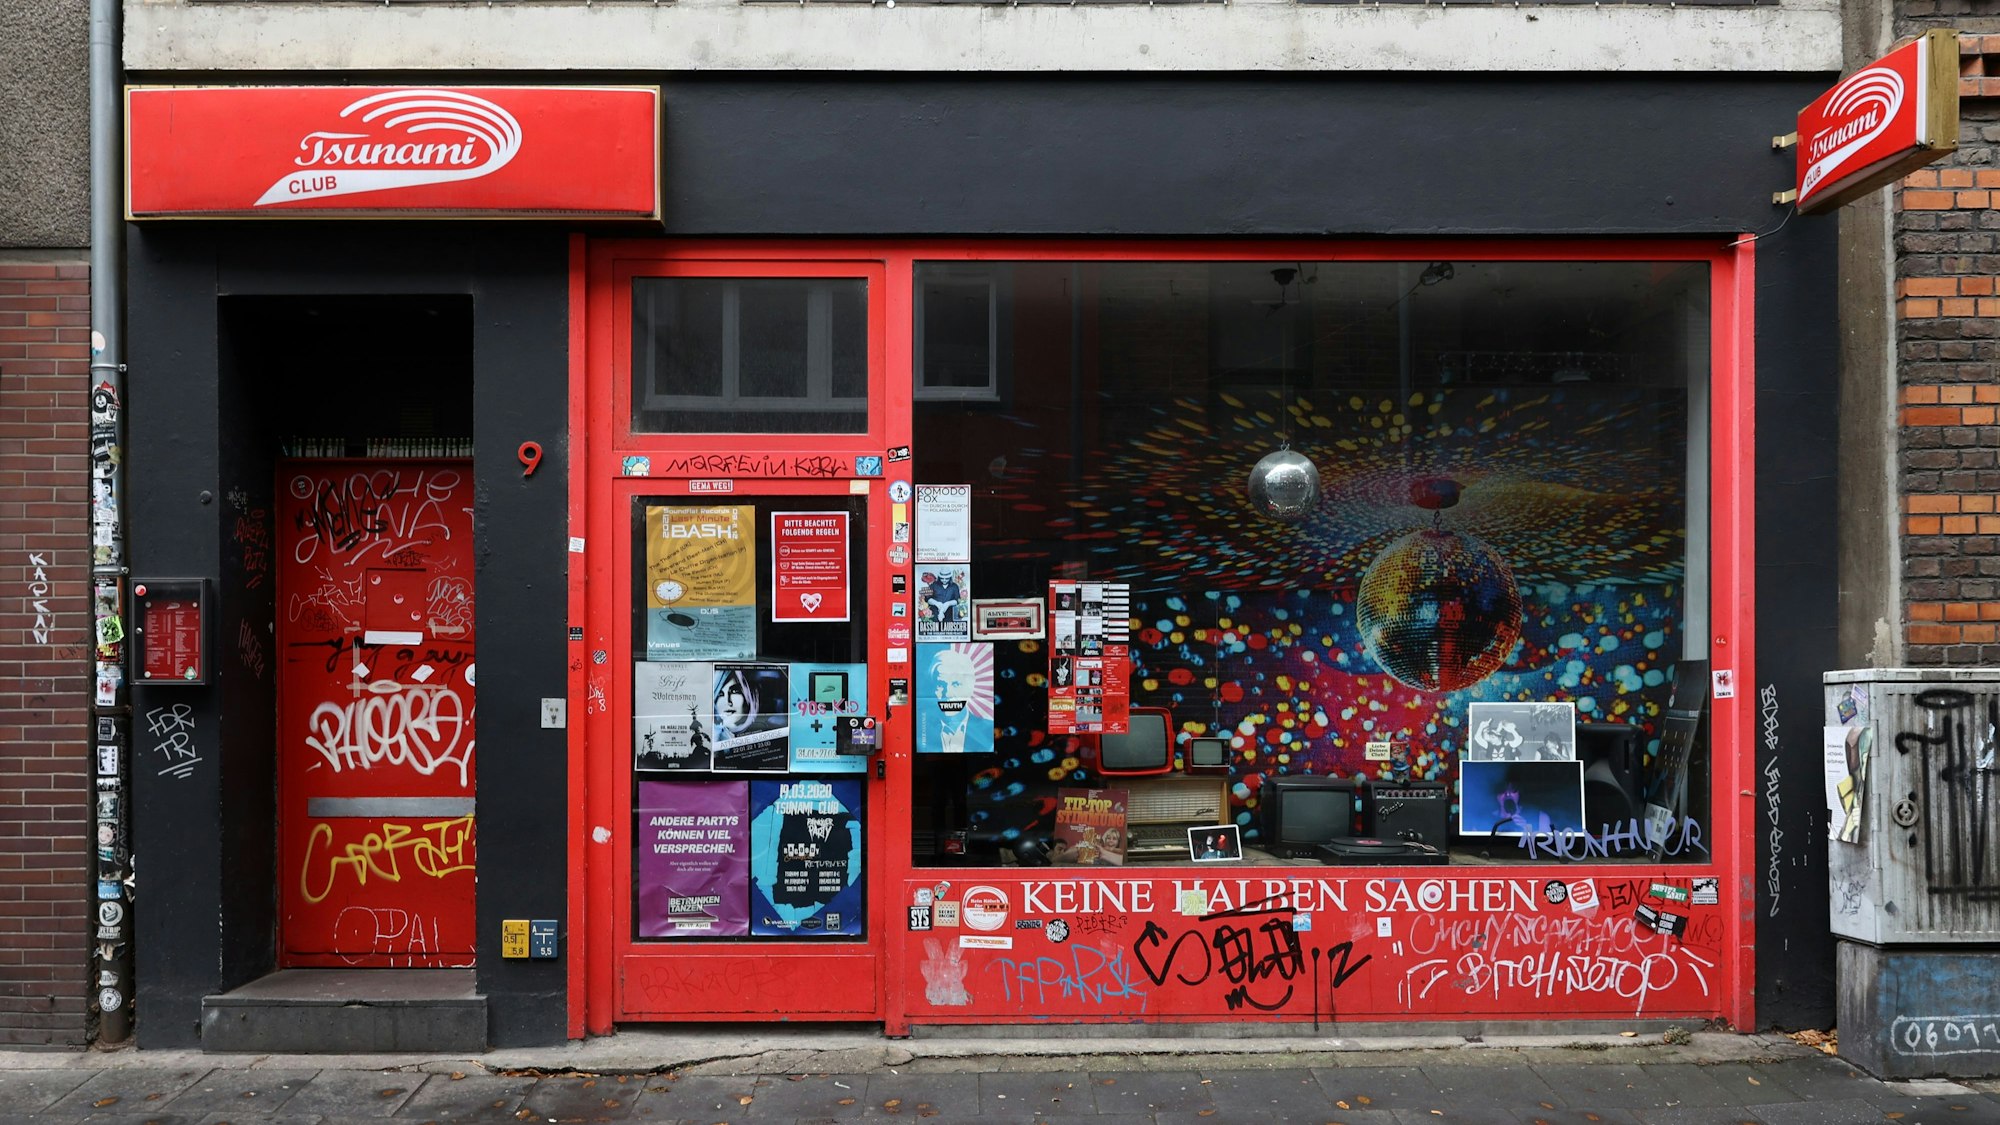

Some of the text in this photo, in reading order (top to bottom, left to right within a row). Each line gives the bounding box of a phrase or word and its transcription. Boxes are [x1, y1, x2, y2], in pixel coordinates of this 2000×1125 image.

[1808, 102, 1879, 164] Tsunami
[294, 131, 477, 166] Tsunami
[1806, 166, 1822, 188] CLUB
[288, 176, 337, 195] CLUB
[518, 441, 543, 476] 9
[691, 481, 731, 490] GEMA WEG!
[917, 487, 967, 496] KOMODO
[917, 495, 938, 503] FOX
[670, 515, 694, 523] Last
[672, 524, 732, 539] BASH
[798, 698, 859, 716] 90s KID
[720, 735, 751, 749] ATTAQUE
[780, 784, 832, 799] 19.03.2020
[776, 801, 839, 816] TSUNAMI CLUB
[1064, 797, 1113, 813] TIP-TOP
[650, 816, 738, 826] ANDERE PARTYS
[1056, 809, 1125, 828] STIMMUNG
[658, 829, 731, 839] KÖNNEN VIEL
[808, 825, 832, 843] PARTY
[654, 844, 735, 854] VERSPRECHEN.
[670, 896, 720, 906] BETRUNKEN
[1020, 881, 1155, 913] KEINE
[1366, 880, 1539, 912] SACHEN
[670, 904, 702, 912] TANZEN
[911, 909, 929, 927] SYS
[504, 925, 509, 933] A
[532, 925, 537, 933] A
[540, 947, 552, 957] 5,5
